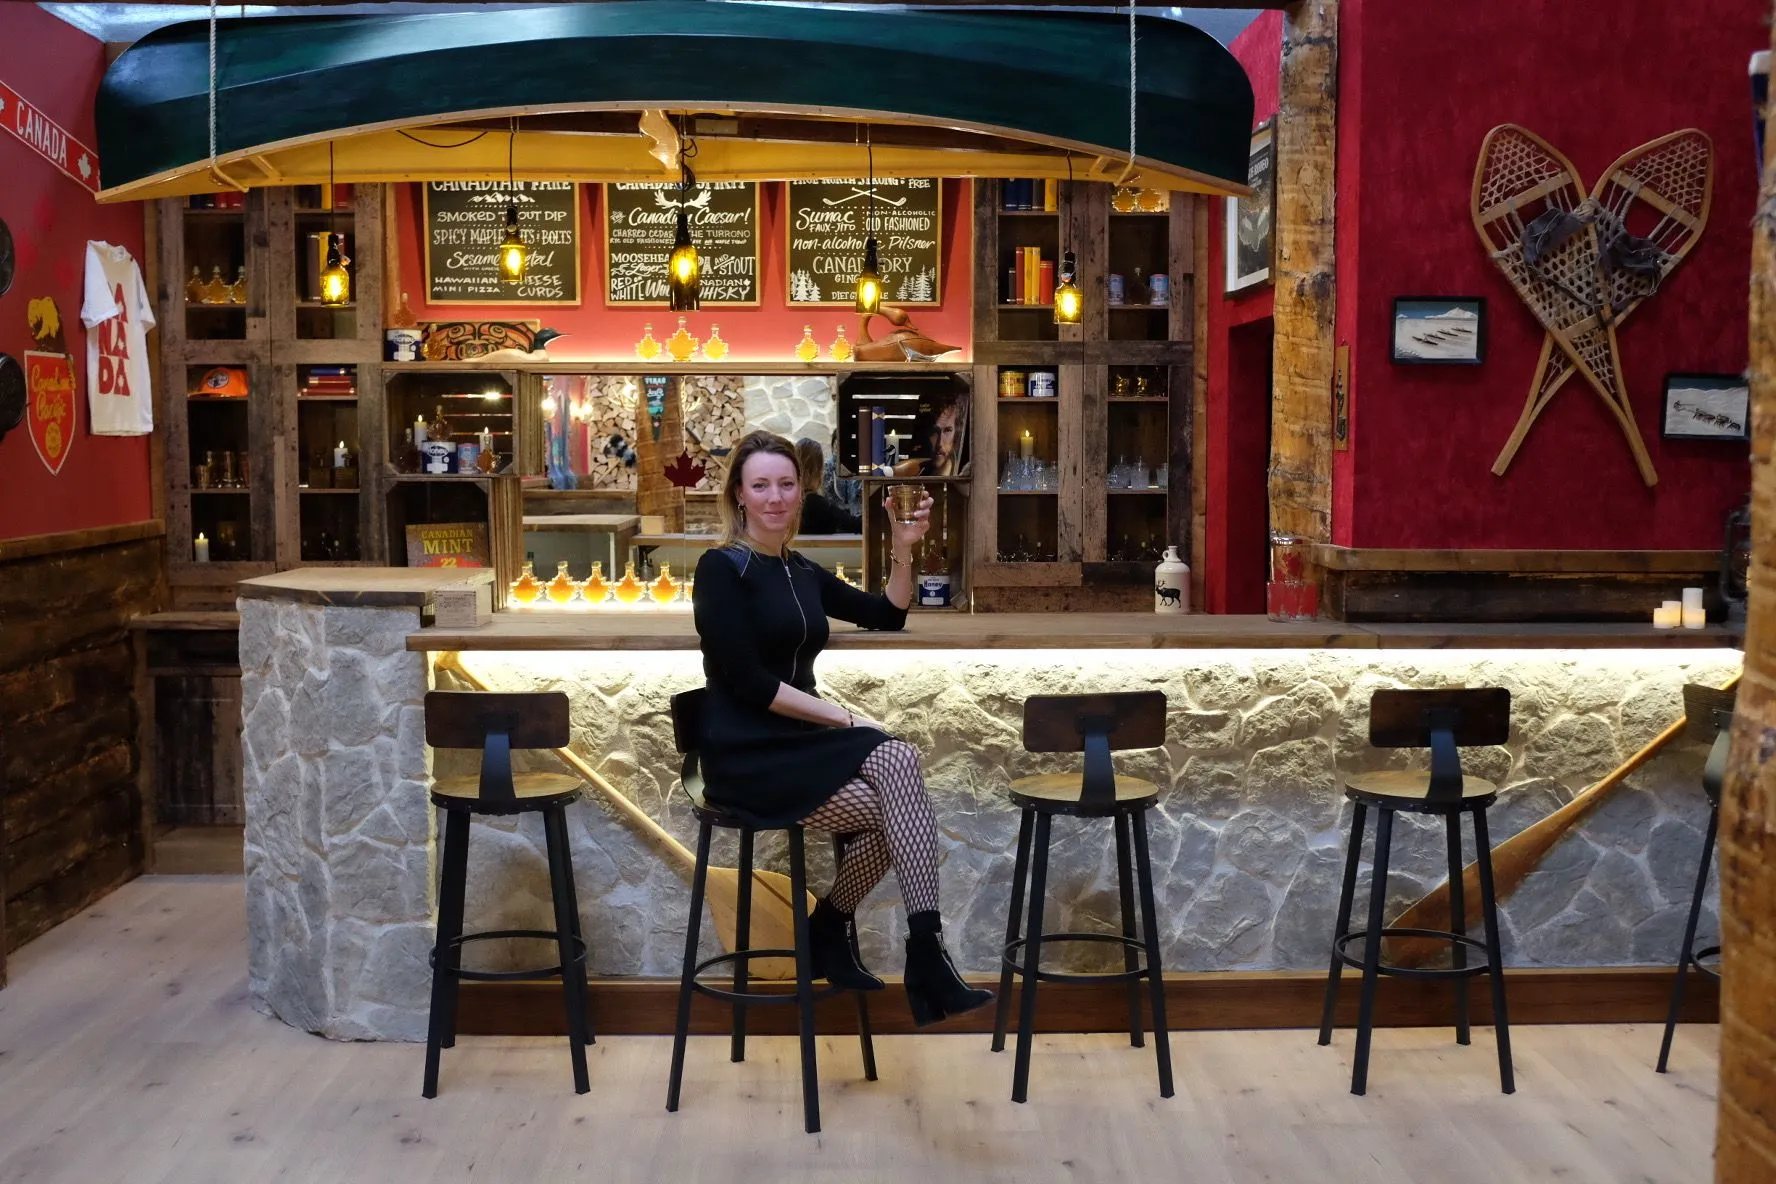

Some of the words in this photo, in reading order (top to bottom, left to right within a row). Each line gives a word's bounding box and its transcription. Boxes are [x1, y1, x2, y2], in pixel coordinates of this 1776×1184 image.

[16, 100, 67, 168] CANADA
[498, 211, 542, 222] TOUT
[545, 211, 567, 221] DIP
[694, 206, 752, 225] Caesar!
[795, 207, 856, 231] Sumac
[865, 217, 881, 231] OLD
[884, 216, 931, 231] FASHIONED
[433, 228, 467, 245] SPICY
[541, 230, 572, 245] BOLTS
[888, 235, 936, 250] Pilsner
[447, 251, 501, 268] Sesame
[611, 253, 670, 263] MOOSEHEA
[697, 255, 714, 275] PA
[719, 256, 756, 275] STOUT
[812, 256, 866, 273] CANAD
[879, 256, 912, 273] DRY
[434, 276, 498, 284] HAWAIIAN
[610, 276, 632, 292] RED
[699, 279, 743, 287] NADIAN
[834, 273, 860, 284] GING
[517, 286, 563, 298] CURDS
[610, 280, 645, 300] WHITE
[644, 279, 671, 298] Win
[831, 291, 850, 300] DIET
[421, 529, 473, 539] CANADIAN
[423, 538, 474, 555] MINT
[440, 557, 457, 568] 22
